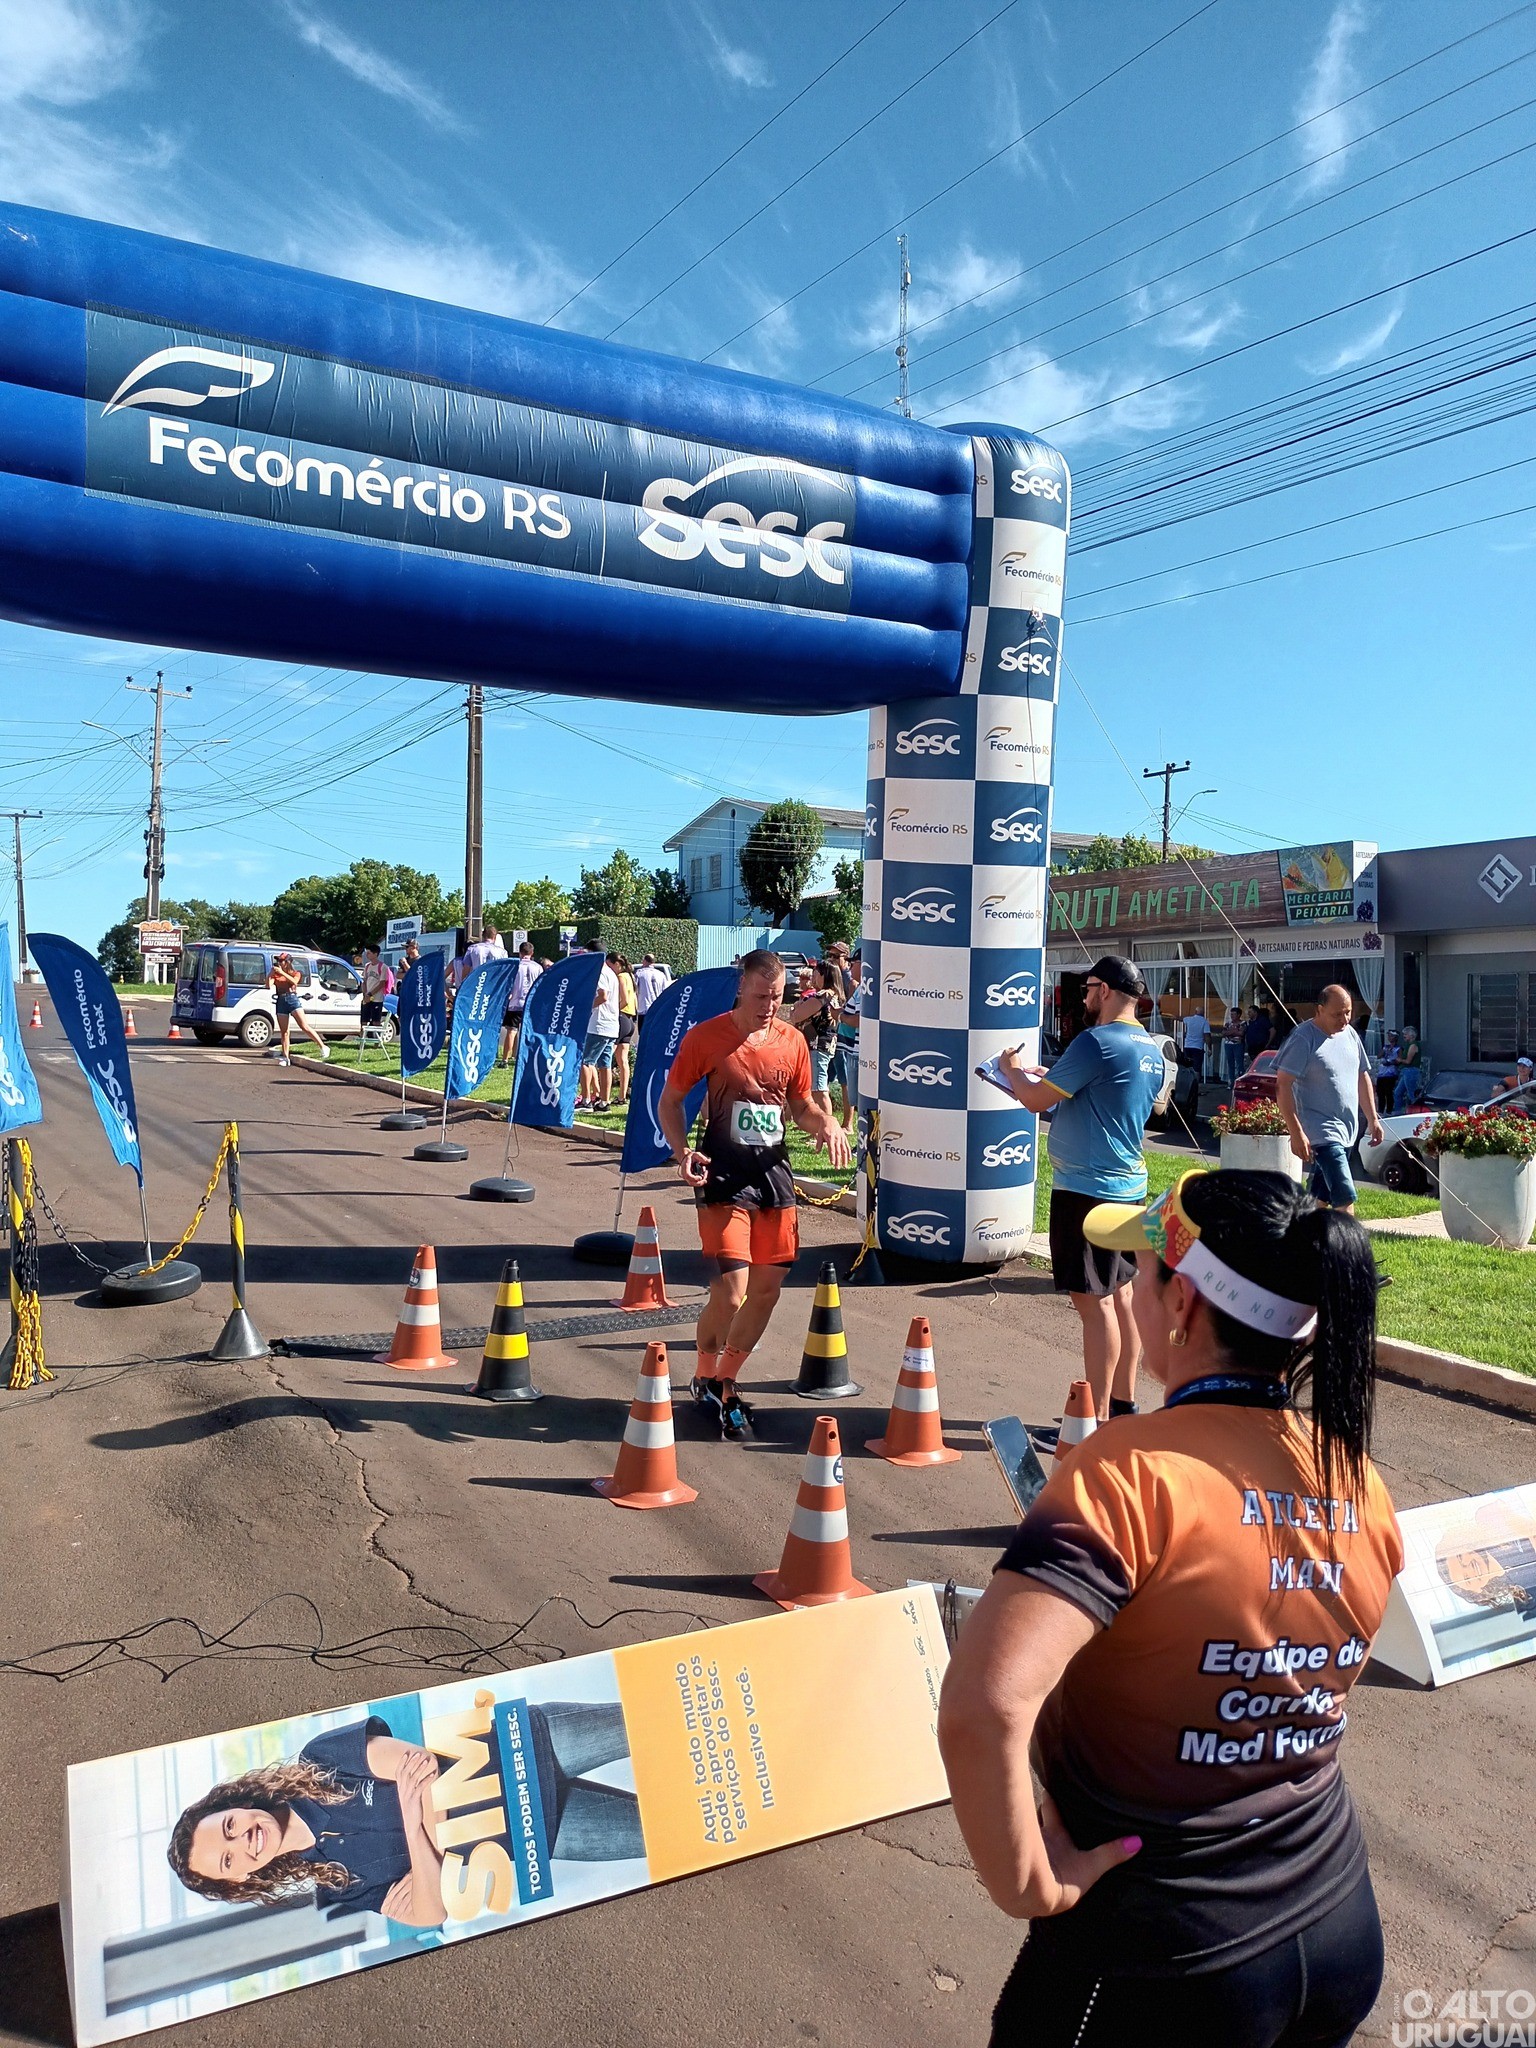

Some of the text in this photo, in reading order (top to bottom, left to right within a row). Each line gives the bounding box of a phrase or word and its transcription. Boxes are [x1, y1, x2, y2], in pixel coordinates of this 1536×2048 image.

[149, 416, 572, 540] Fecomércio RS
[1010, 463, 1062, 503] Sesc
[638, 456, 847, 586] Sesc
[1005, 566, 1062, 586] Fecomércio RS
[998, 637, 1052, 676] Sesc
[877, 740, 884, 749] RS
[895, 719, 960, 755] Sesc
[990, 741, 1050, 755] Fecomércio RS
[891, 822, 968, 835] Fecomércio RS
[990, 807, 1043, 844] Sesc
[872, 902, 880, 912] RS
[891, 887, 956, 923] Sesc
[985, 909, 1042, 919] Fecomércio RS
[1050, 879, 1260, 931] RUTI AMETISTA
[1288, 891, 1352, 904] MERCEARIA
[1295, 905, 1349, 918] PEIXARIA
[1258, 938, 1361, 953] ARTESANATO E PEDRAS NATURAIS
[469, 971, 487, 1020] Fecomércio
[479, 994, 491, 1021] Senac
[548, 978, 569, 1034] Fecomércio
[887, 985, 964, 1000] Fecomércio RS
[985, 971, 1036, 1007] Sesc
[73, 969, 96, 1050] Fecomércio
[93, 1003, 107, 1046] Senac
[561, 1005, 575, 1036] Senac
[665, 985, 693, 1056] Fecomércio
[410, 1013, 433, 1059] Sesc
[458, 1028, 482, 1084] Sesc
[868, 1060, 877, 1070] RS
[888, 1050, 952, 1086] Sesc
[534, 1043, 567, 1108] Sesc
[94, 1059, 137, 1143] Sesc
[885, 1143, 961, 1161] Fecomércio RS
[982, 1130, 1031, 1167] Sesc
[887, 1210, 950, 1245] Sesc
[978, 1226, 1025, 1241] Fecomércio
[1203, 1270, 1239, 1302] RUN
[1250, 1303, 1275, 1321] NO
[1241, 1489, 1359, 1533] ATLETA
[1269, 1556, 1344, 1594] MAN
[1201, 1637, 1329, 1679] Equipe
[676, 1662, 719, 1843] Aqui, todo mundo
[691, 1655, 737, 1843] pode aproveitar os
[708, 1660, 747, 1830] serviços do Sesc.
[736, 1666, 774, 1809] Inclusive você.
[1181, 1731, 1265, 1763] Med
[362, 1780, 375, 1806] Sesc
[423, 1689, 515, 1921] SIM,
[507, 1706, 542, 1894] TODOS PODEM SER SESC.
